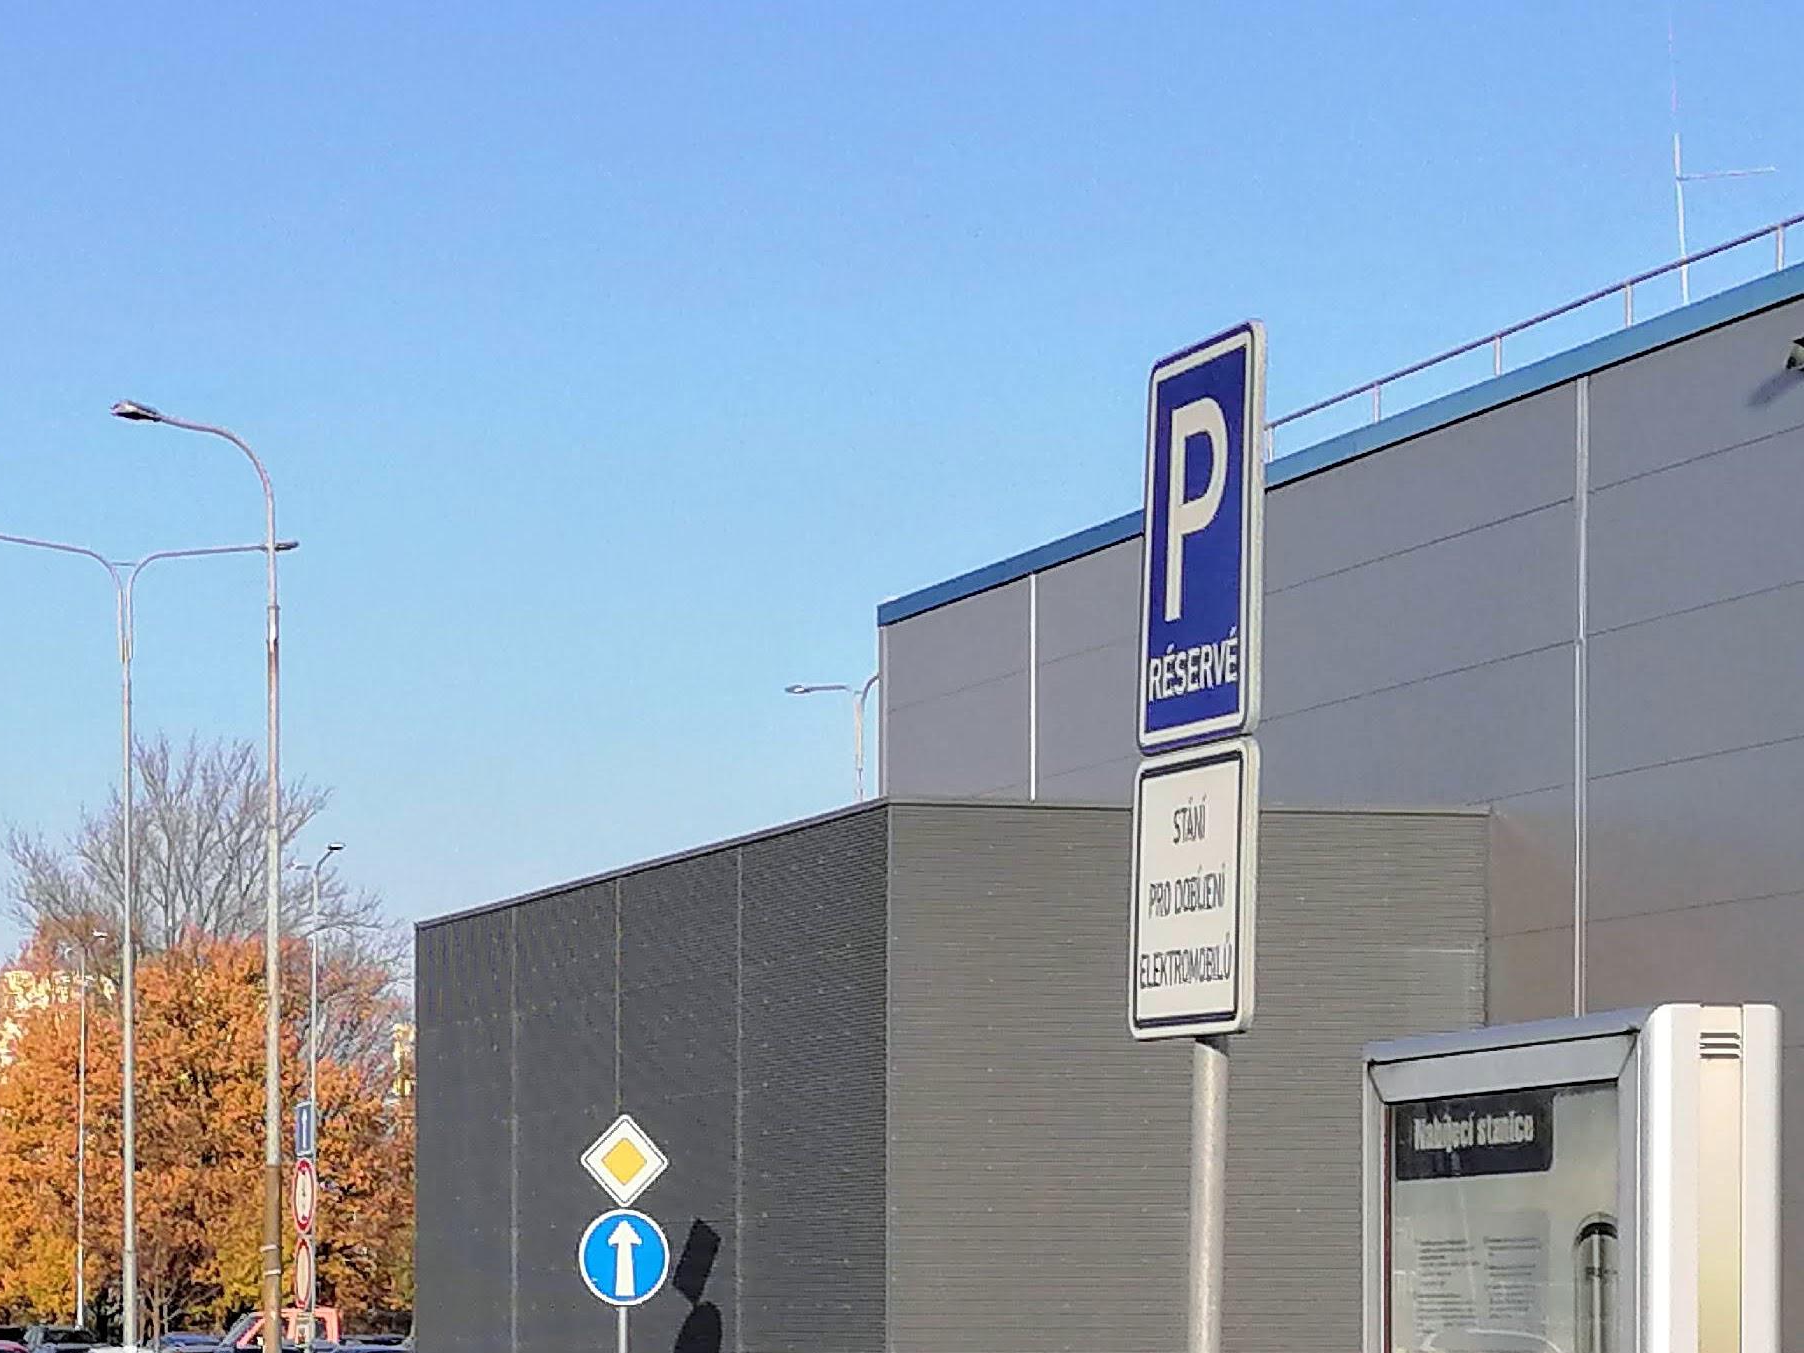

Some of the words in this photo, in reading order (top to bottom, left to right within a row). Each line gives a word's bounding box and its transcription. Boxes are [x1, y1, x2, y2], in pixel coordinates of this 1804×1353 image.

[1163, 396, 1229, 622] P
[1147, 627, 1238, 702] RÉSERVÉ
[1172, 795, 1207, 844] STÁNÍ
[1148, 878, 1171, 918] PRO
